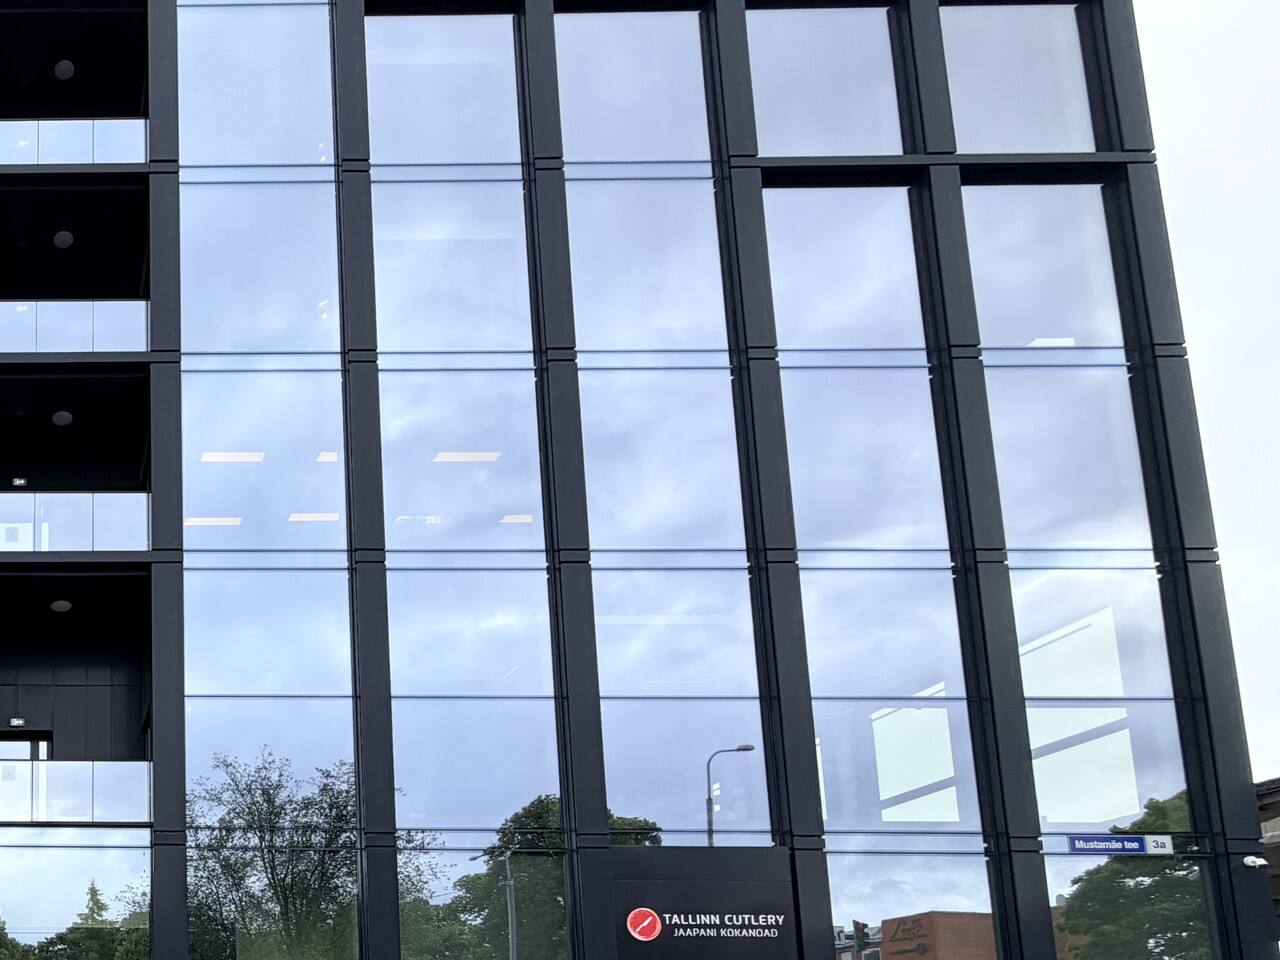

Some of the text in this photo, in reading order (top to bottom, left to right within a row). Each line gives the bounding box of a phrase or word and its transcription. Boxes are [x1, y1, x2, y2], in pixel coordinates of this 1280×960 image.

[1074, 839, 1167, 849] Mustamäe tee 3a
[663, 913, 785, 926] TALLINN CUTLERY
[673, 928, 779, 938] JAAPANI KOKANOAD
